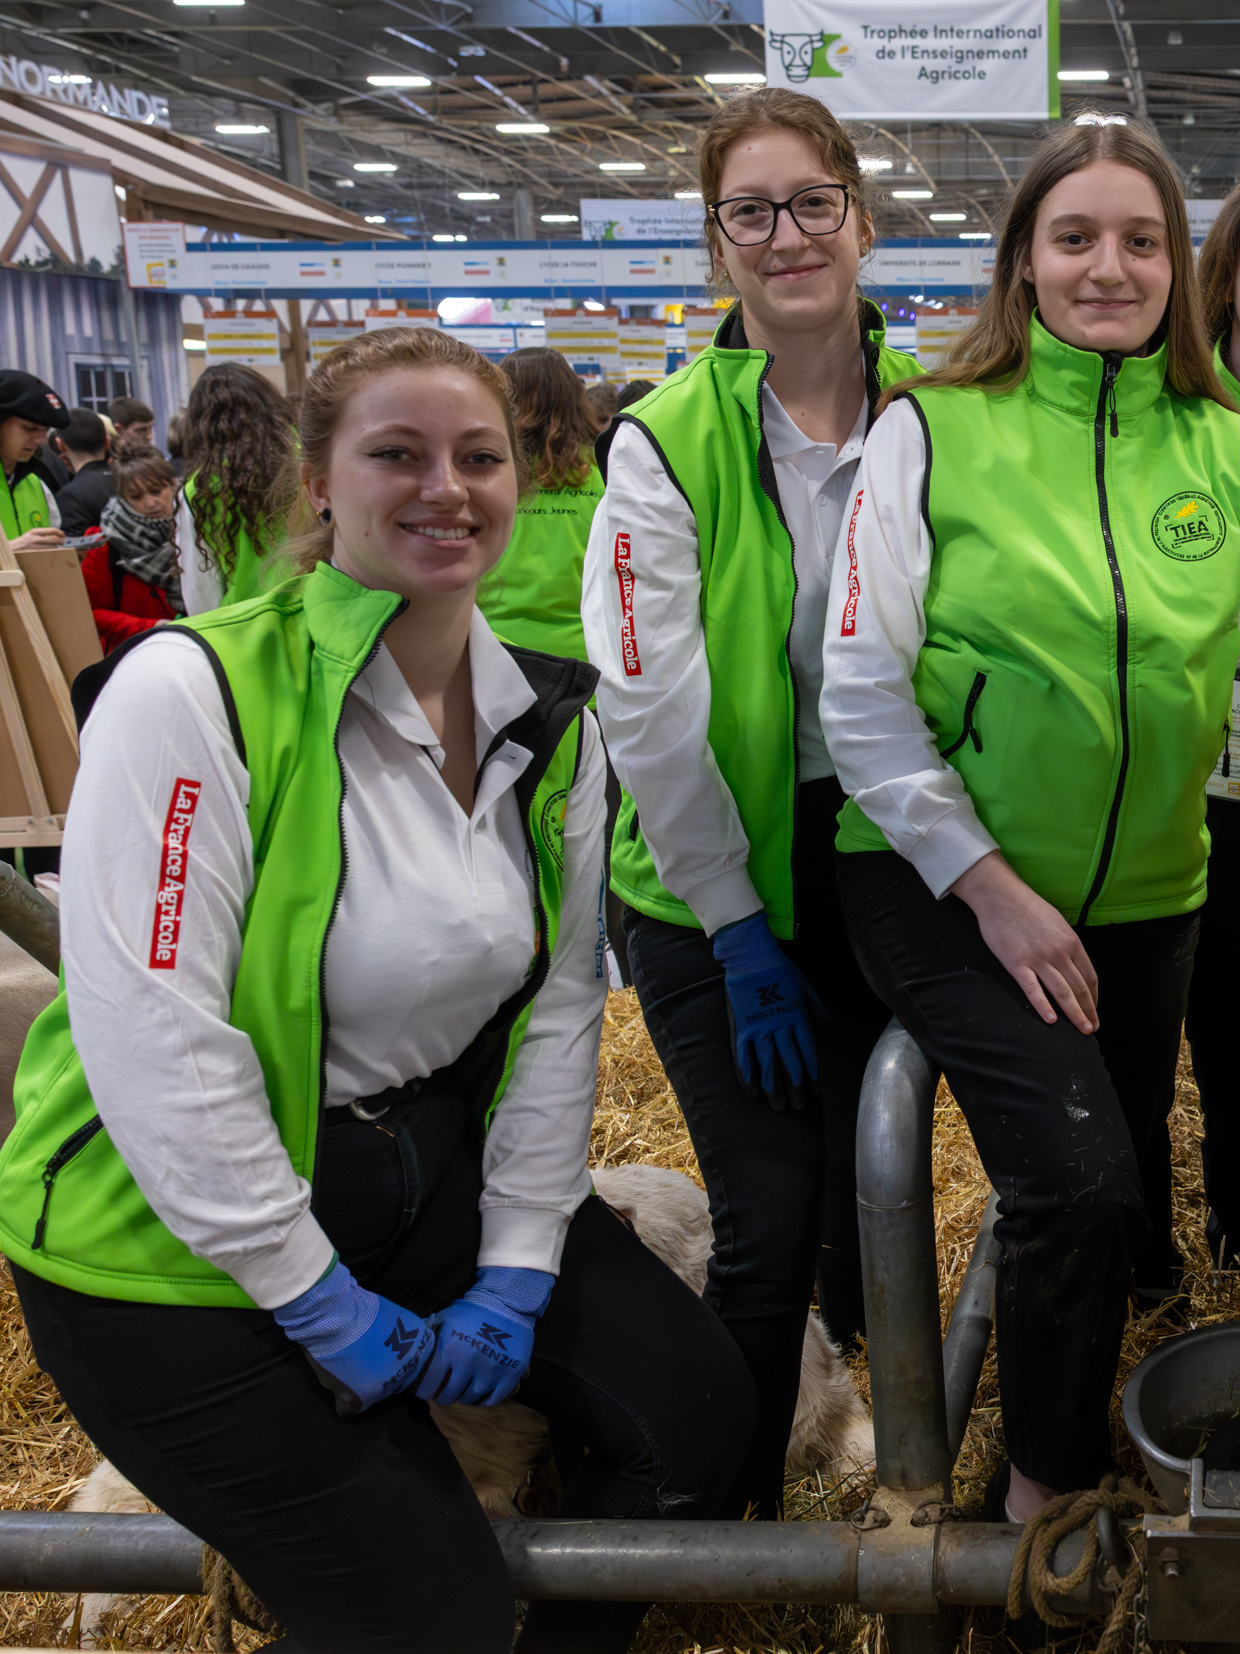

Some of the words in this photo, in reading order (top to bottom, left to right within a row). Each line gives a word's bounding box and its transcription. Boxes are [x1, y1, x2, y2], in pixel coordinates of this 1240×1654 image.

[861, 25, 928, 42] Trophée
[934, 25, 1042, 40] International
[876, 46, 896, 60] de
[902, 45, 1028, 63] l'Enseignement
[0, 55, 172, 130] NORMANDE
[917, 66, 987, 84] Agricole
[515, 507, 547, 515] oncours
[550, 507, 577, 515] Jeunes
[1170, 520, 1209, 538] TIEA
[618, 537, 630, 556] La
[848, 514, 859, 567] France
[618, 557, 633, 606] France
[844, 569, 860, 630] Agricole
[621, 608, 638, 670] Agricole
[176, 784, 200, 810] La
[166, 810, 193, 876] France
[156, 877, 184, 961] Agricole
[451, 1328, 522, 1370] McKENZIE
